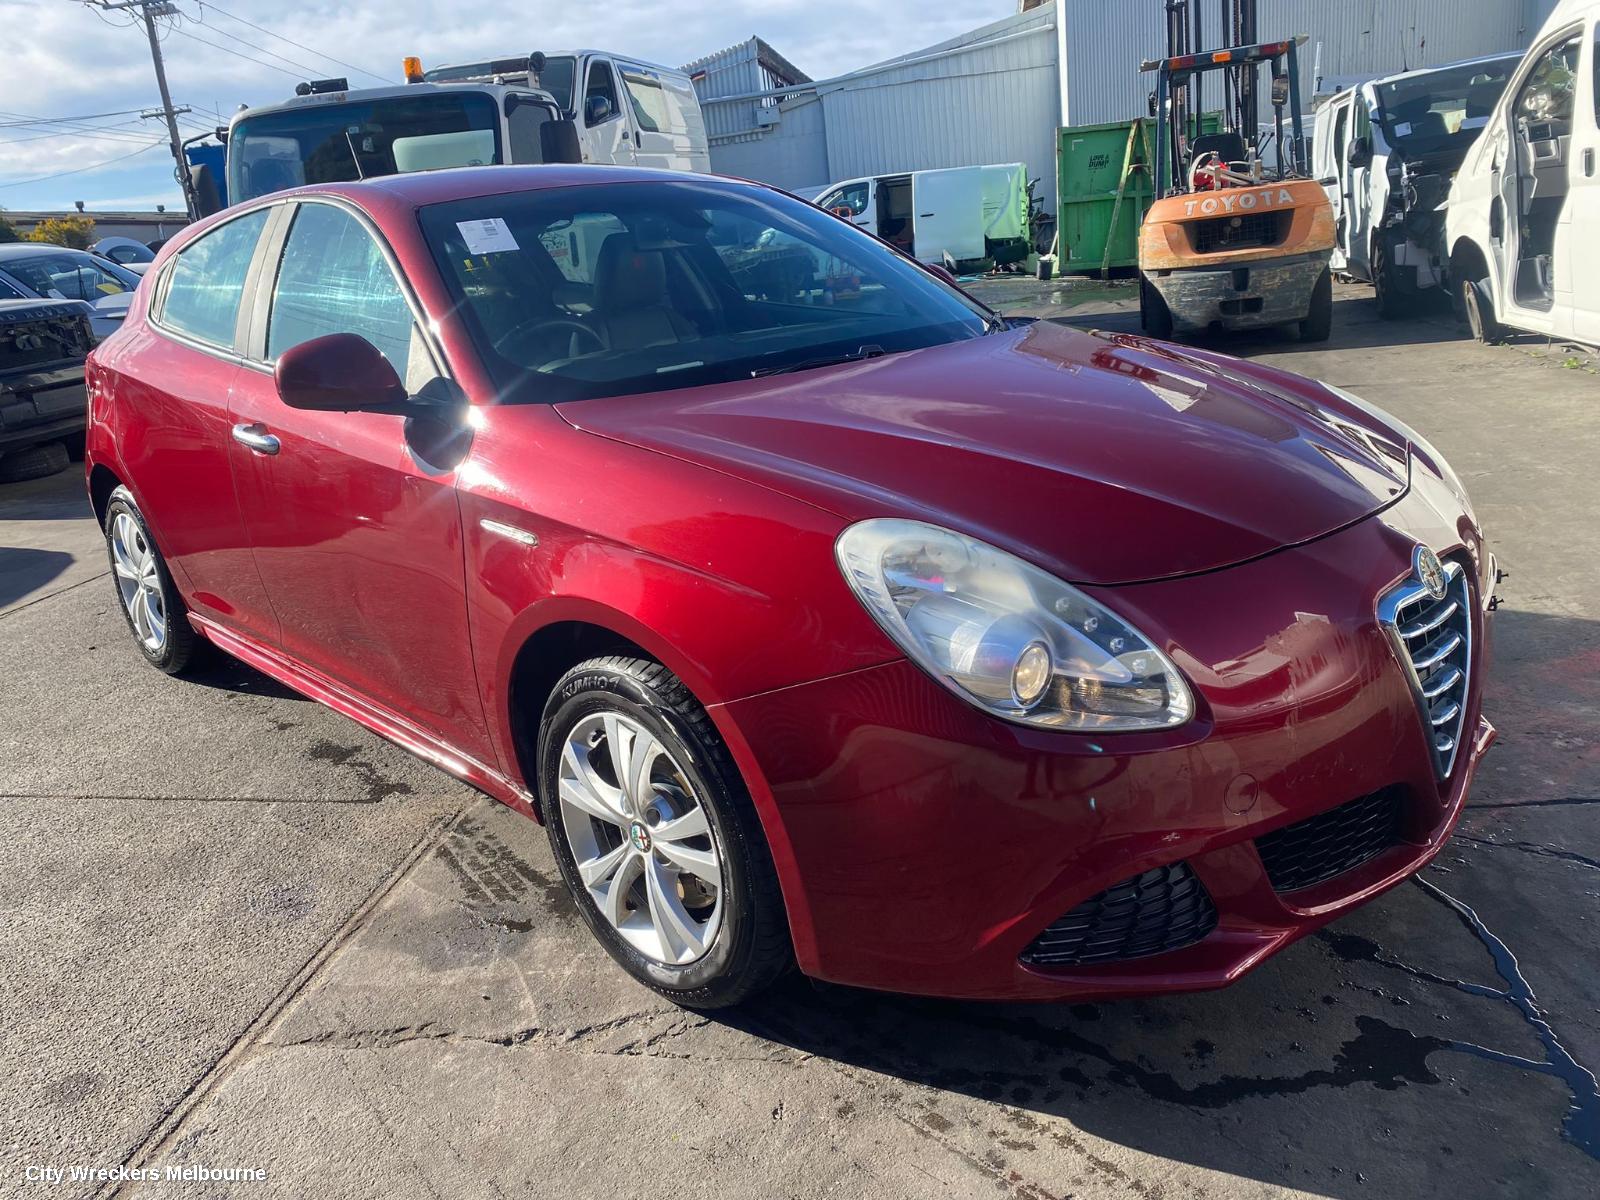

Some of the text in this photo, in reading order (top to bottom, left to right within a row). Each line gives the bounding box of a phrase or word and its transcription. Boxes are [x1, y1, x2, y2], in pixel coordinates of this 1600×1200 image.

[1088, 159, 1110, 169] DUMP
[1184, 188, 1294, 216] TOYOTA
[562, 676, 609, 698] KUMHO
